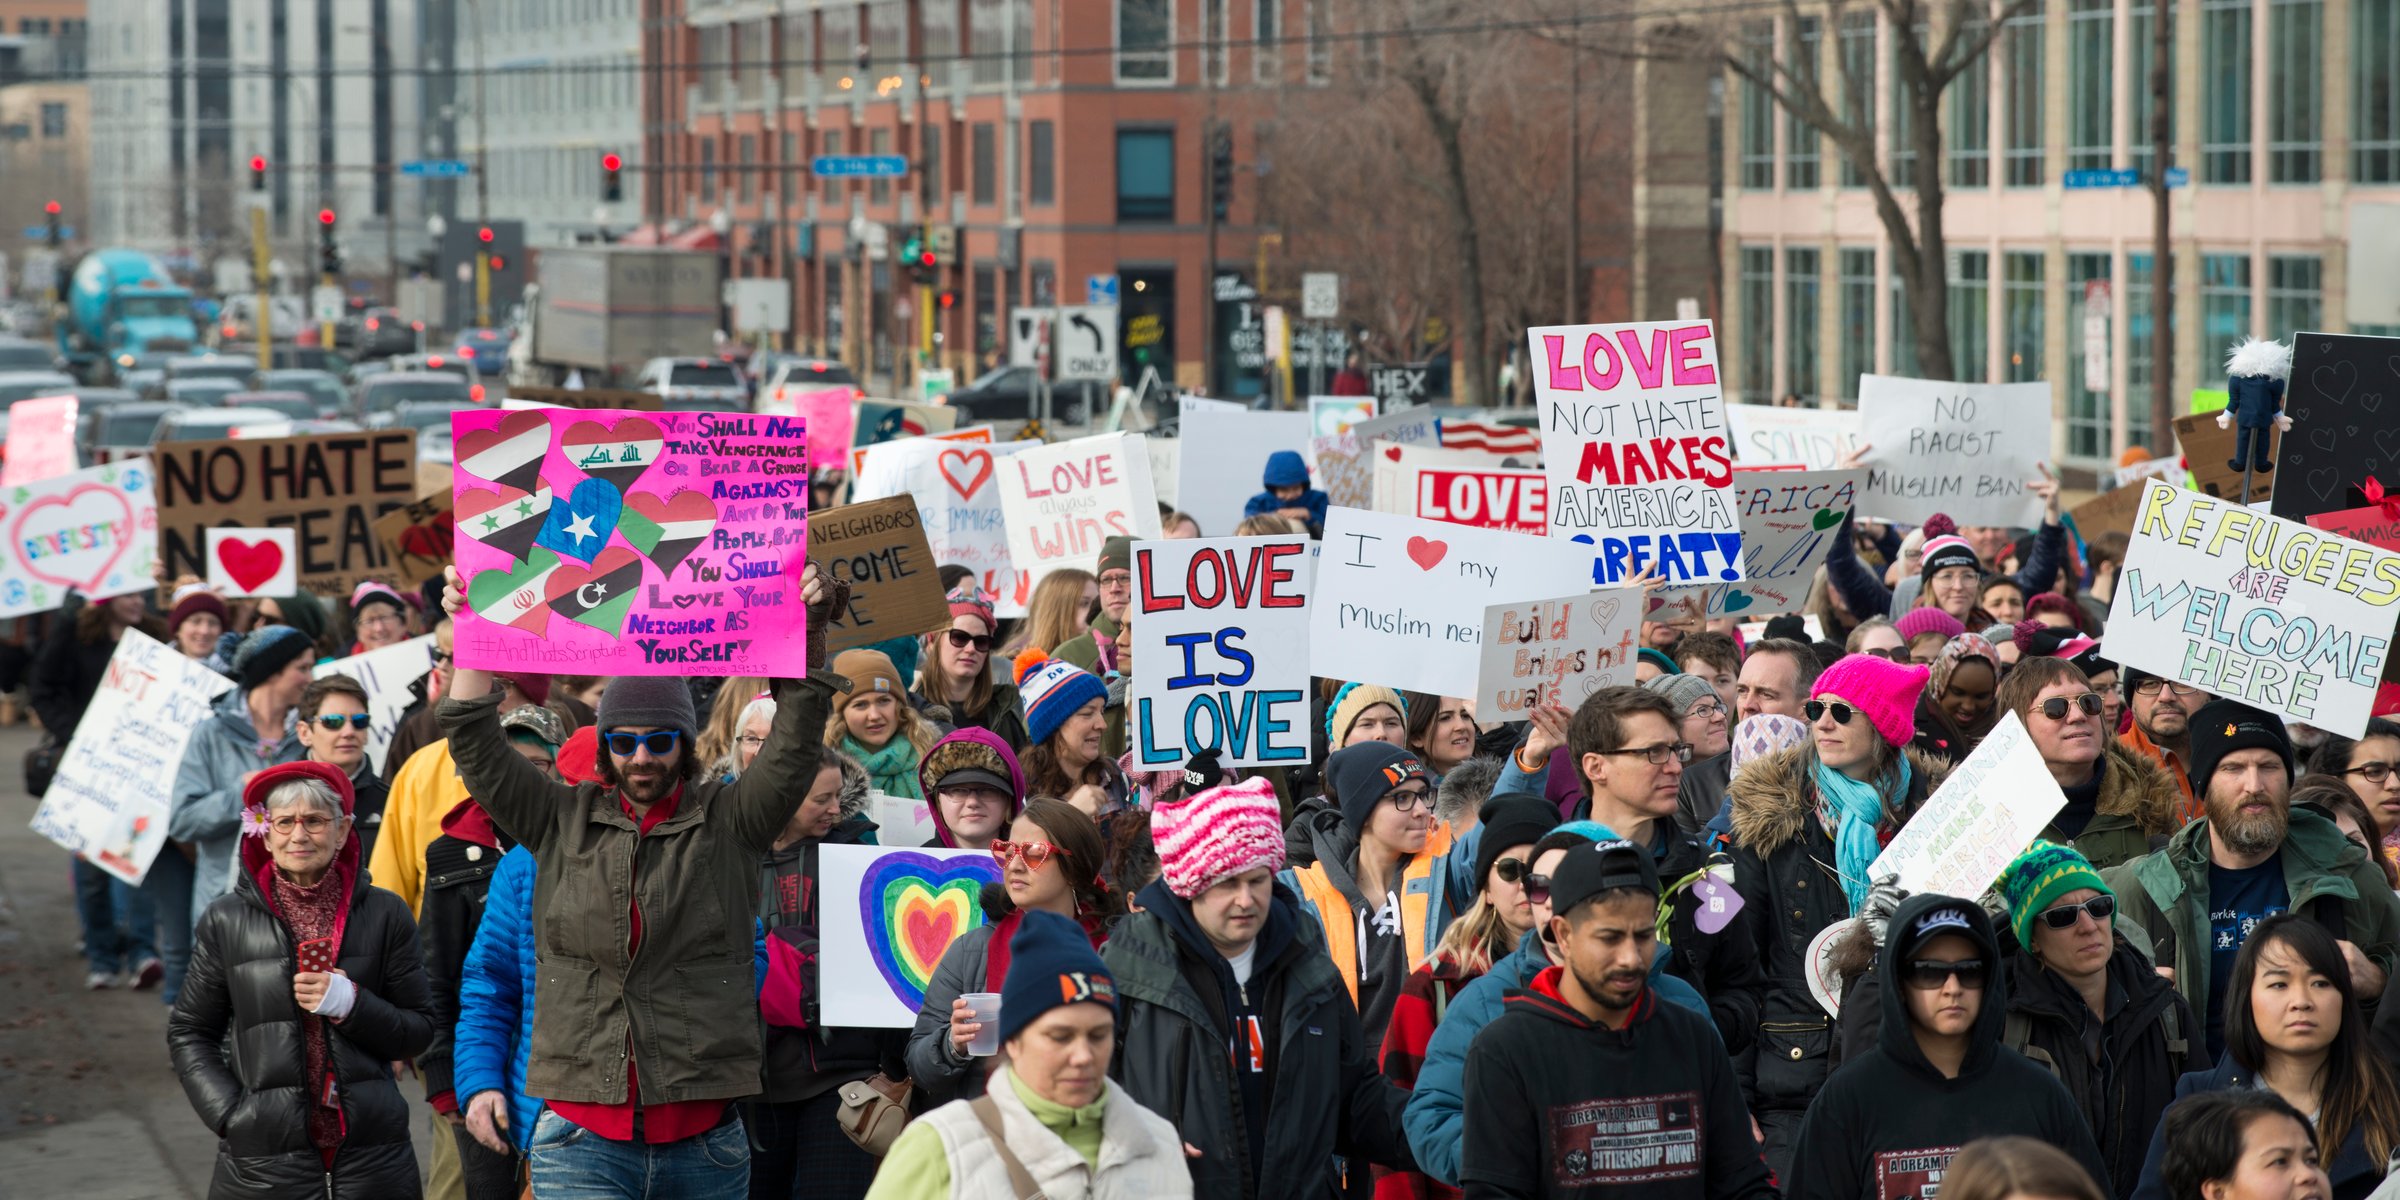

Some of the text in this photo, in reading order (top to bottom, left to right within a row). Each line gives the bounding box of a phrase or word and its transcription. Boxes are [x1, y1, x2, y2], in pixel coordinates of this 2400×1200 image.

[1070, 359, 1111, 373] ONLY
[1543, 325, 1717, 391] LOVE
[1372, 369, 1426, 396] HEX
[1553, 397, 1720, 437] NOT HATE
[1934, 395, 1976, 423] NO
[1909, 428, 2001, 456] RACIST
[162, 435, 412, 507] NO HATE
[1018, 454, 1119, 499] LOVE
[1576, 436, 1733, 489] MAKES
[1420, 473, 1545, 522] LOVE
[1867, 469, 2024, 498] MUSLIM BAN
[1040, 494, 1097, 516] always
[1555, 485, 1732, 529] AMERICA
[812, 509, 915, 544] NEIGHBORS
[1764, 521, 1807, 534] immigrant
[2140, 485, 2400, 606] REFUGEES
[831, 546, 918, 584] COME
[1137, 543, 1305, 614] LOVE
[1345, 533, 1498, 588] I my
[984, 568, 1031, 607] LOV
[2229, 566, 2289, 605] ARE
[1446, 624, 1480, 644] nei
[1498, 601, 1572, 644] Build
[2127, 569, 2387, 688] WELCOME
[730, 664, 768, 673] 19:18
[1166, 626, 1255, 690] IS
[1513, 648, 1587, 688] Bridges
[1597, 629, 1634, 669] not
[1497, 683, 1562, 711] walls
[2179, 639, 2323, 720] HERE
[1139, 689, 1306, 765] LOVE
[1878, 718, 2021, 875] IMMIGRANTS
[1920, 802, 2014, 895] MERICA
[1924, 794, 1986, 864] MAKE
[1948, 824, 2018, 903] REAT
[1569, 1107, 1608, 1126] DREAM
[1609, 1106, 1626, 1120] FOR
[1592, 1143, 1696, 1170] CITIZENSHIP NOW!
[1889, 1158, 1899, 1174] A
[1900, 1154, 1942, 1173] DREAM
[1928, 1171, 1941, 1182] NO
